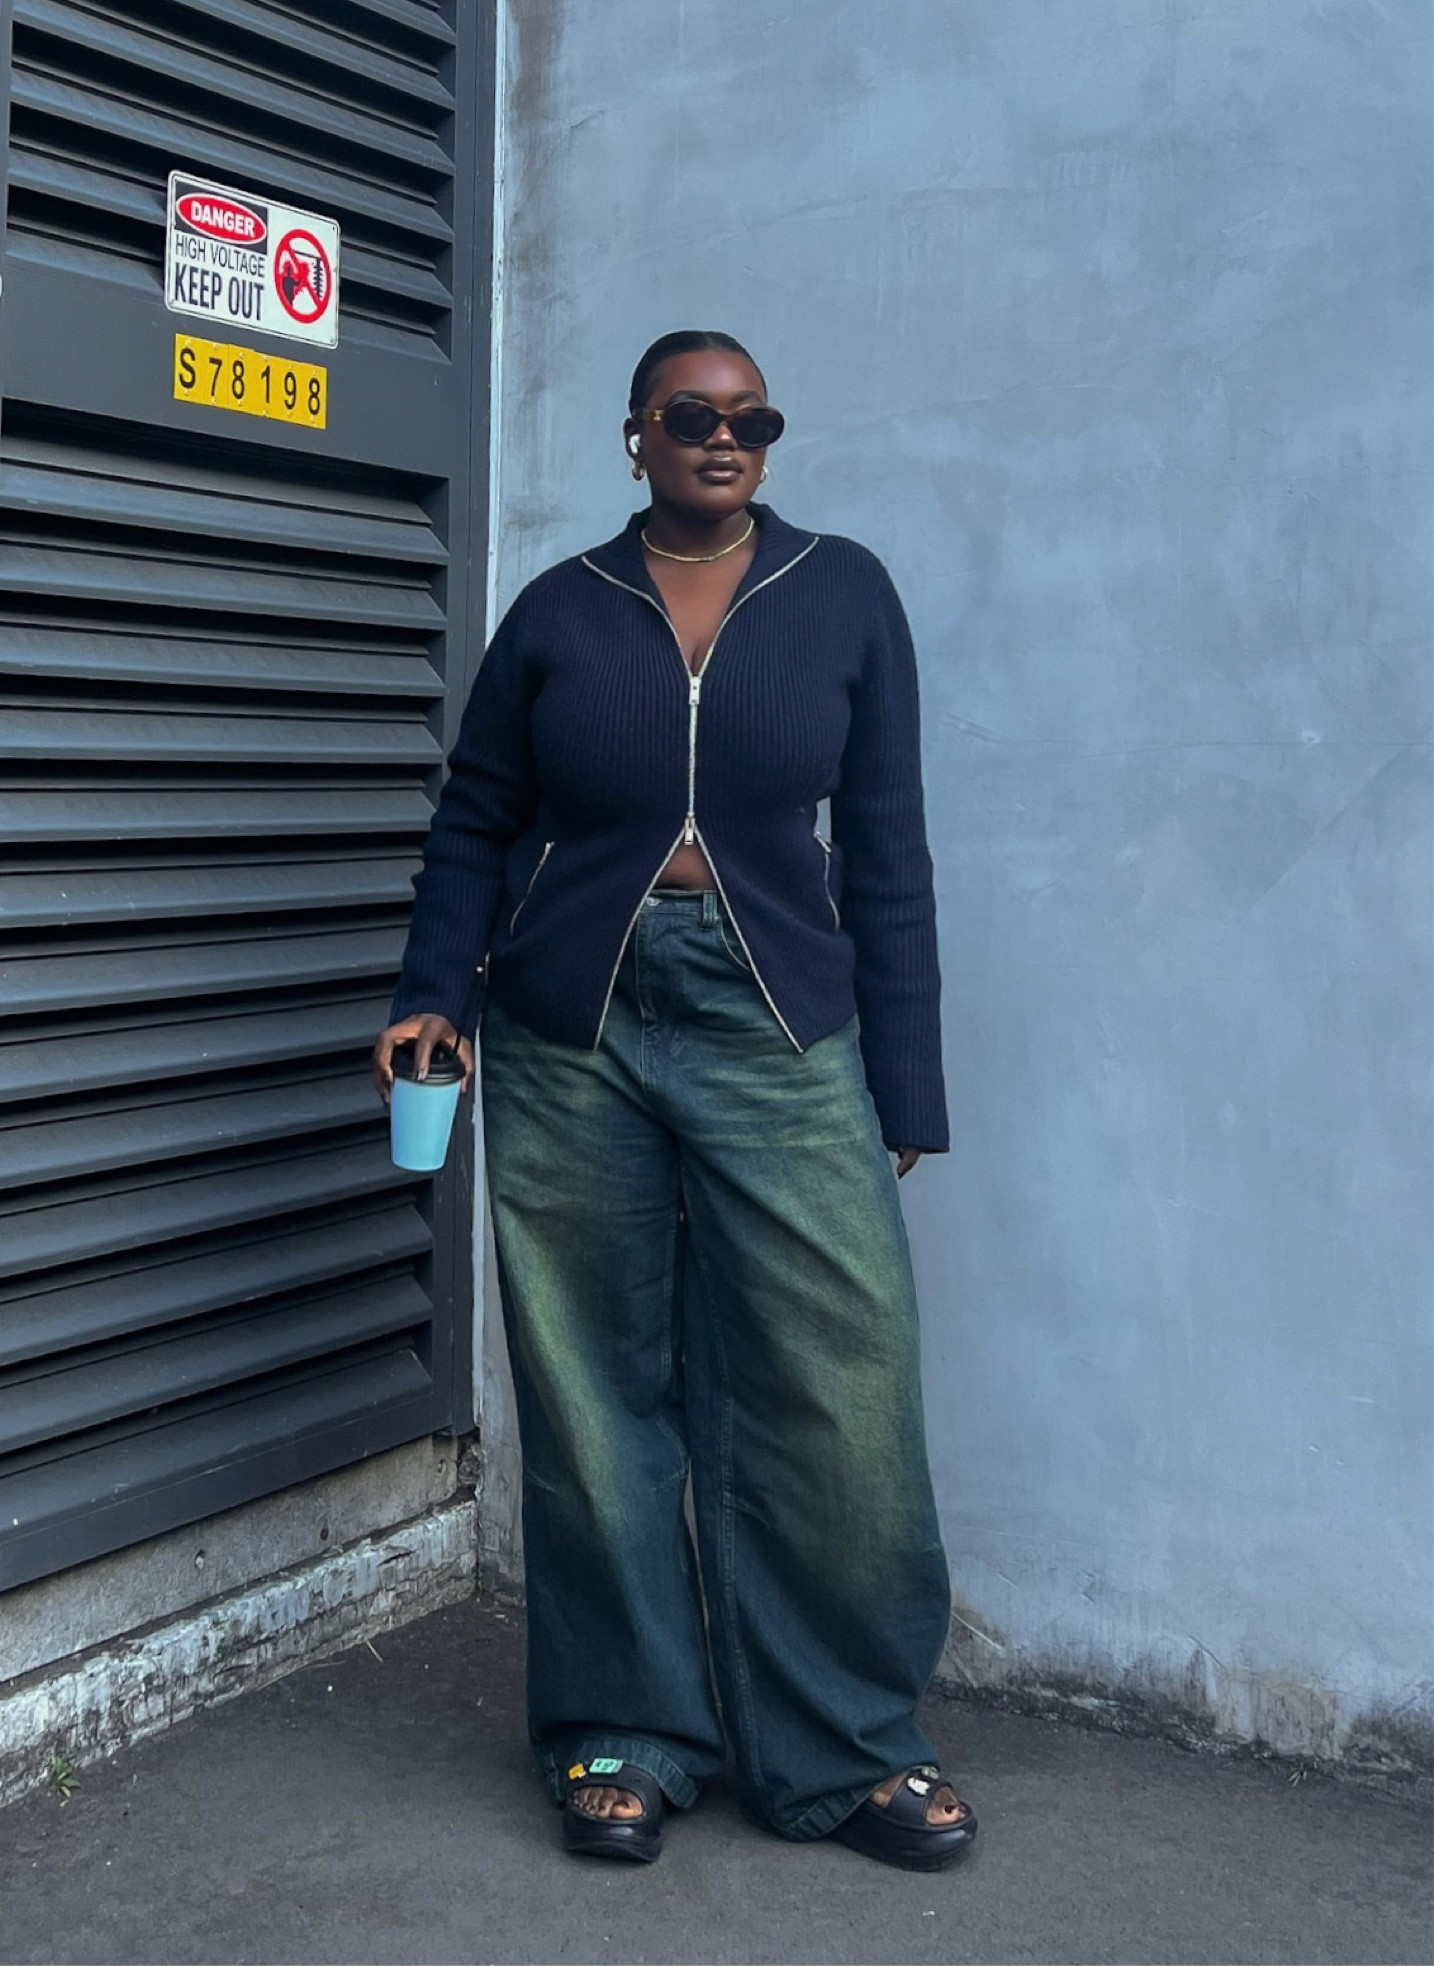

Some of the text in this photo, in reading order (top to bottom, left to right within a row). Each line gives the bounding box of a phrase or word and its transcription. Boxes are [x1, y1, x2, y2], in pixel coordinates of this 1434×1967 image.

[191, 201, 256, 238] DANGER
[176, 234, 265, 279] HIGH VOLTAGE
[175, 263, 265, 321] KEEP OUT
[179, 348, 320, 416] S78198
